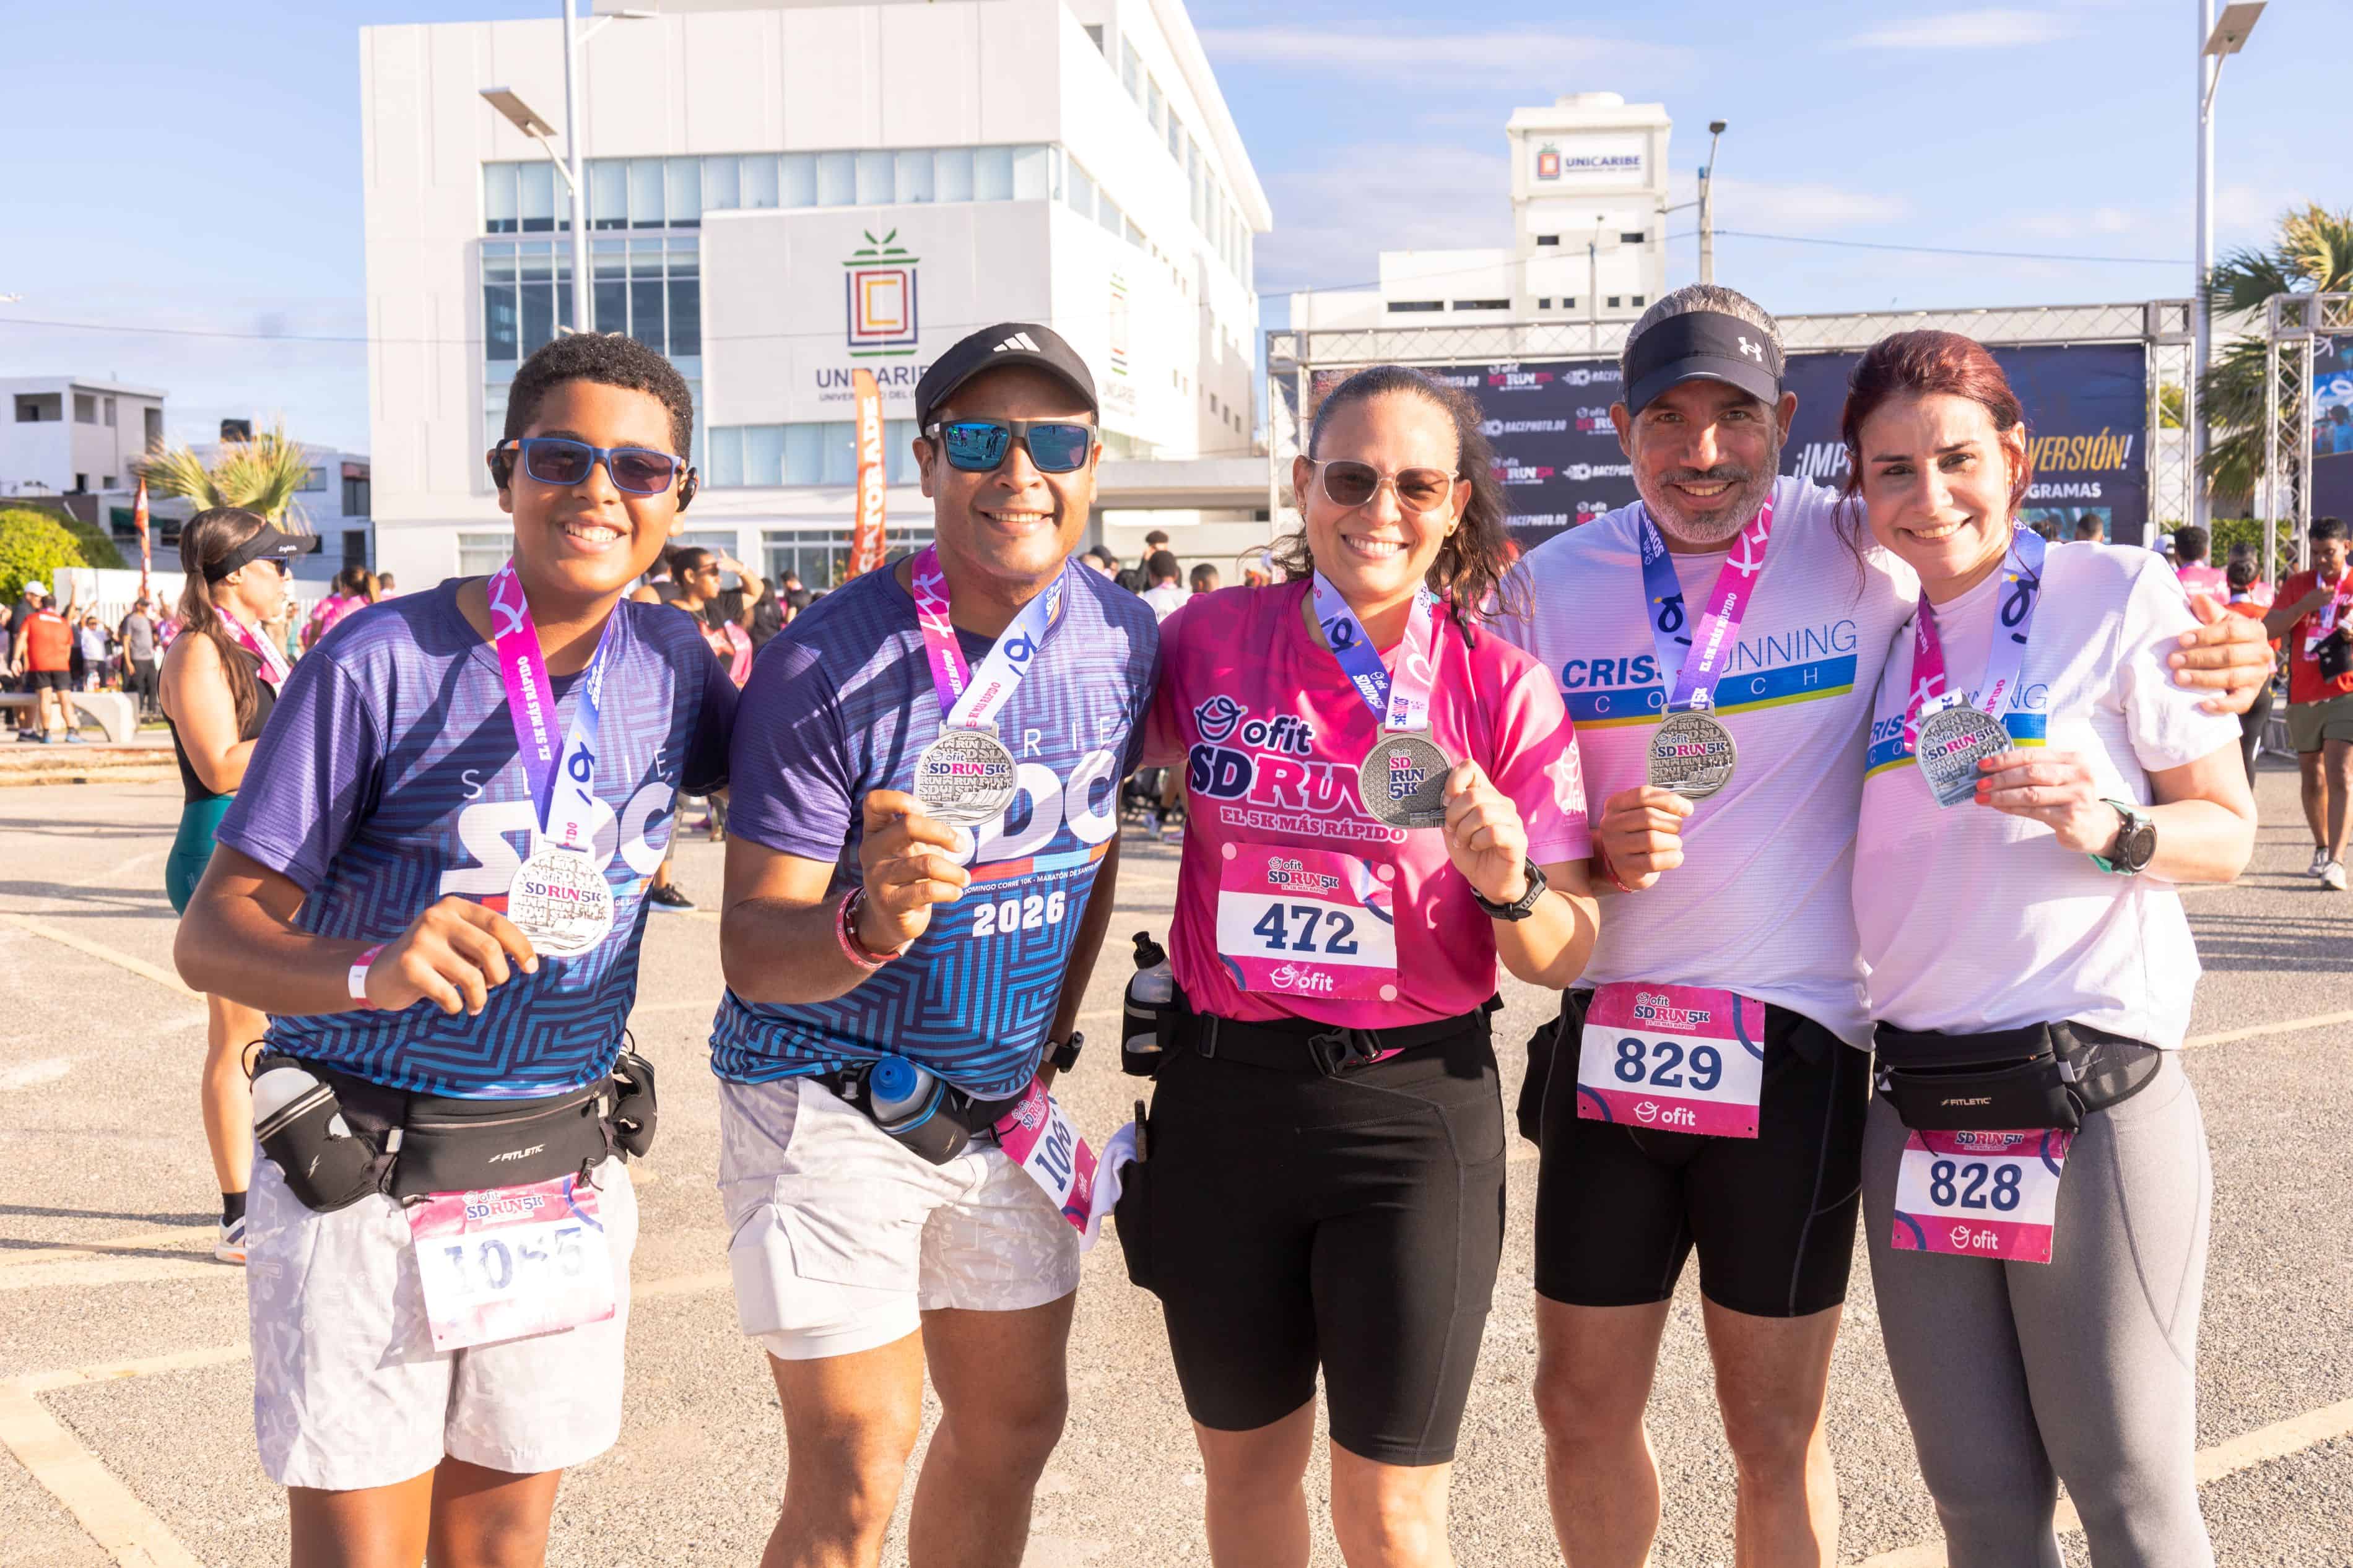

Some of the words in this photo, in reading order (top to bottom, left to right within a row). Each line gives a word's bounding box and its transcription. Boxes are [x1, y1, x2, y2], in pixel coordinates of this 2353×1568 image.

[1565, 155, 1640, 167] UNICARIBE
[1793, 442, 1851, 479] ¡IMP
[2028, 425, 2134, 472] VERSIÓN!
[2028, 482, 2102, 499] GRAMAS
[1562, 655, 1664, 688] CRIS
[1983, 679, 2006, 714] ÁPIDO
[1242, 717, 1313, 753] ofit
[1671, 734, 1688, 743] ofit
[1928, 724, 1994, 761] SDRUN5K
[946, 752, 965, 761] ofit
[1658, 743, 1726, 757] SDRUN5K
[929, 763, 1006, 775] SDRUN5K
[1390, 756, 1412, 769] SD
[1190, 745, 1367, 817] SDRUN
[1390, 768, 1425, 782] RUN
[1388, 782, 1418, 800] 5K
[1220, 808, 1244, 825] EL
[1247, 812, 1277, 831] 5K
[1279, 815, 1320, 836] MÁS
[1323, 820, 1407, 843] RÁPIDO
[1283, 860, 1302, 870] ofit
[998, 880, 1019, 890] CORRE
[1021, 877, 1032, 886] 10K
[1037, 871, 1068, 882] MARATÓN
[1077, 865, 1094, 875] SANTO
[1268, 870, 1338, 888] SDRUN5K
[525, 881, 601, 903] SDRUN5K
[972, 891, 1066, 937] 2026
[1253, 903, 1358, 955] 472
[1297, 972, 1333, 991] ofit
[1651, 995, 1669, 1006] ofit
[1634, 1005, 1709, 1023] SDRUN5K
[1614, 1037, 1722, 1091] 829
[1951, 1098, 1991, 1106] FITLETIC
[1661, 1108, 1695, 1126] ofit
[1955, 1131, 2024, 1146] SDRUN5K
[501, 1143, 546, 1161] FITLETIC
[1930, 1160, 2022, 1210] 828
[466, 1197, 543, 1219] SDRUN5K
[1973, 1229, 1998, 1250] ofit
